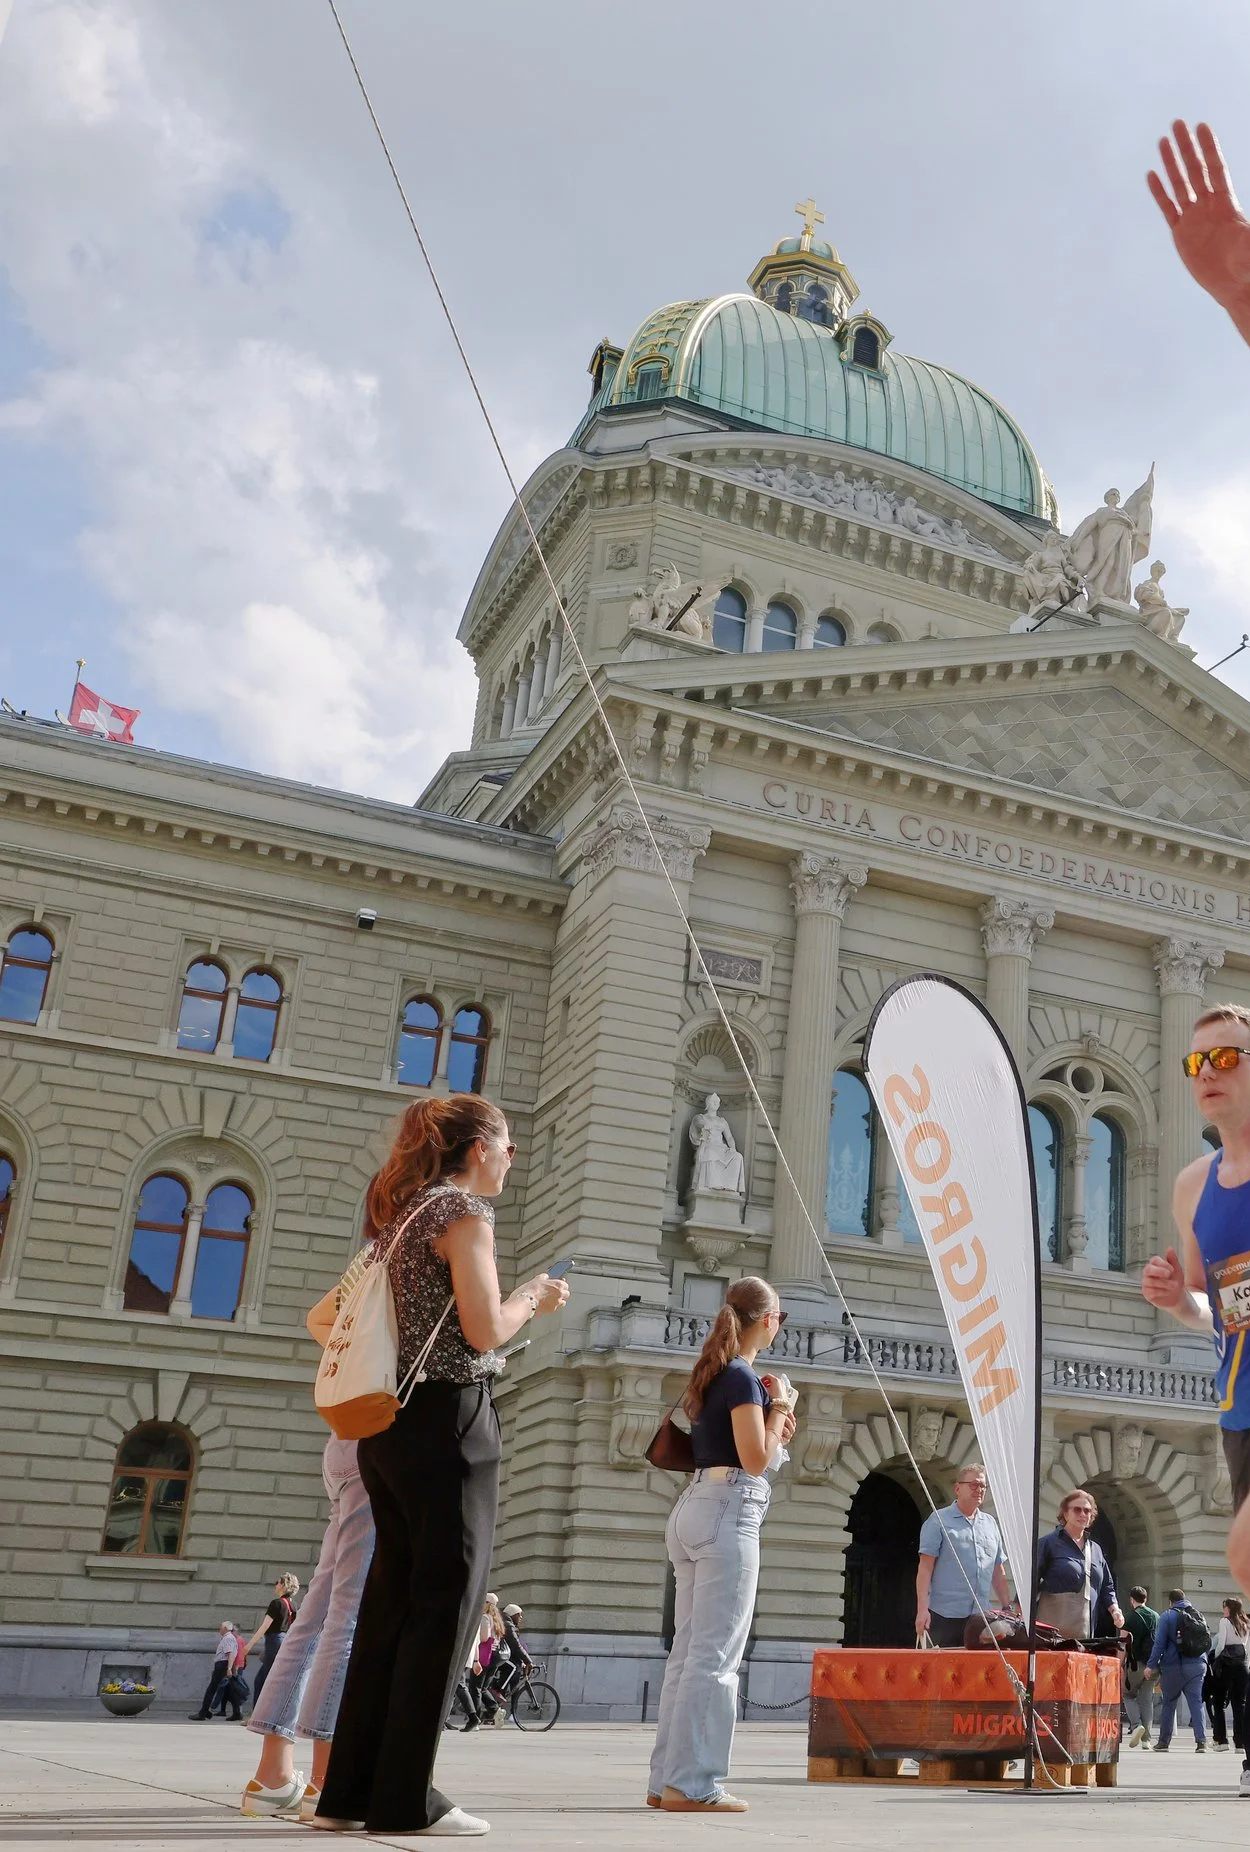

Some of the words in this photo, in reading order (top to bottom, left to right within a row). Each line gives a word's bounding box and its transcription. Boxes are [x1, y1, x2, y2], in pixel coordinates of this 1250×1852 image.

[763, 780, 876, 832] CURIA
[900, 814, 1216, 914] CONFOEDERATIONIS
[1197, 1579, 1203, 1588] 3
[953, 1713, 1053, 1736] MIGROS
